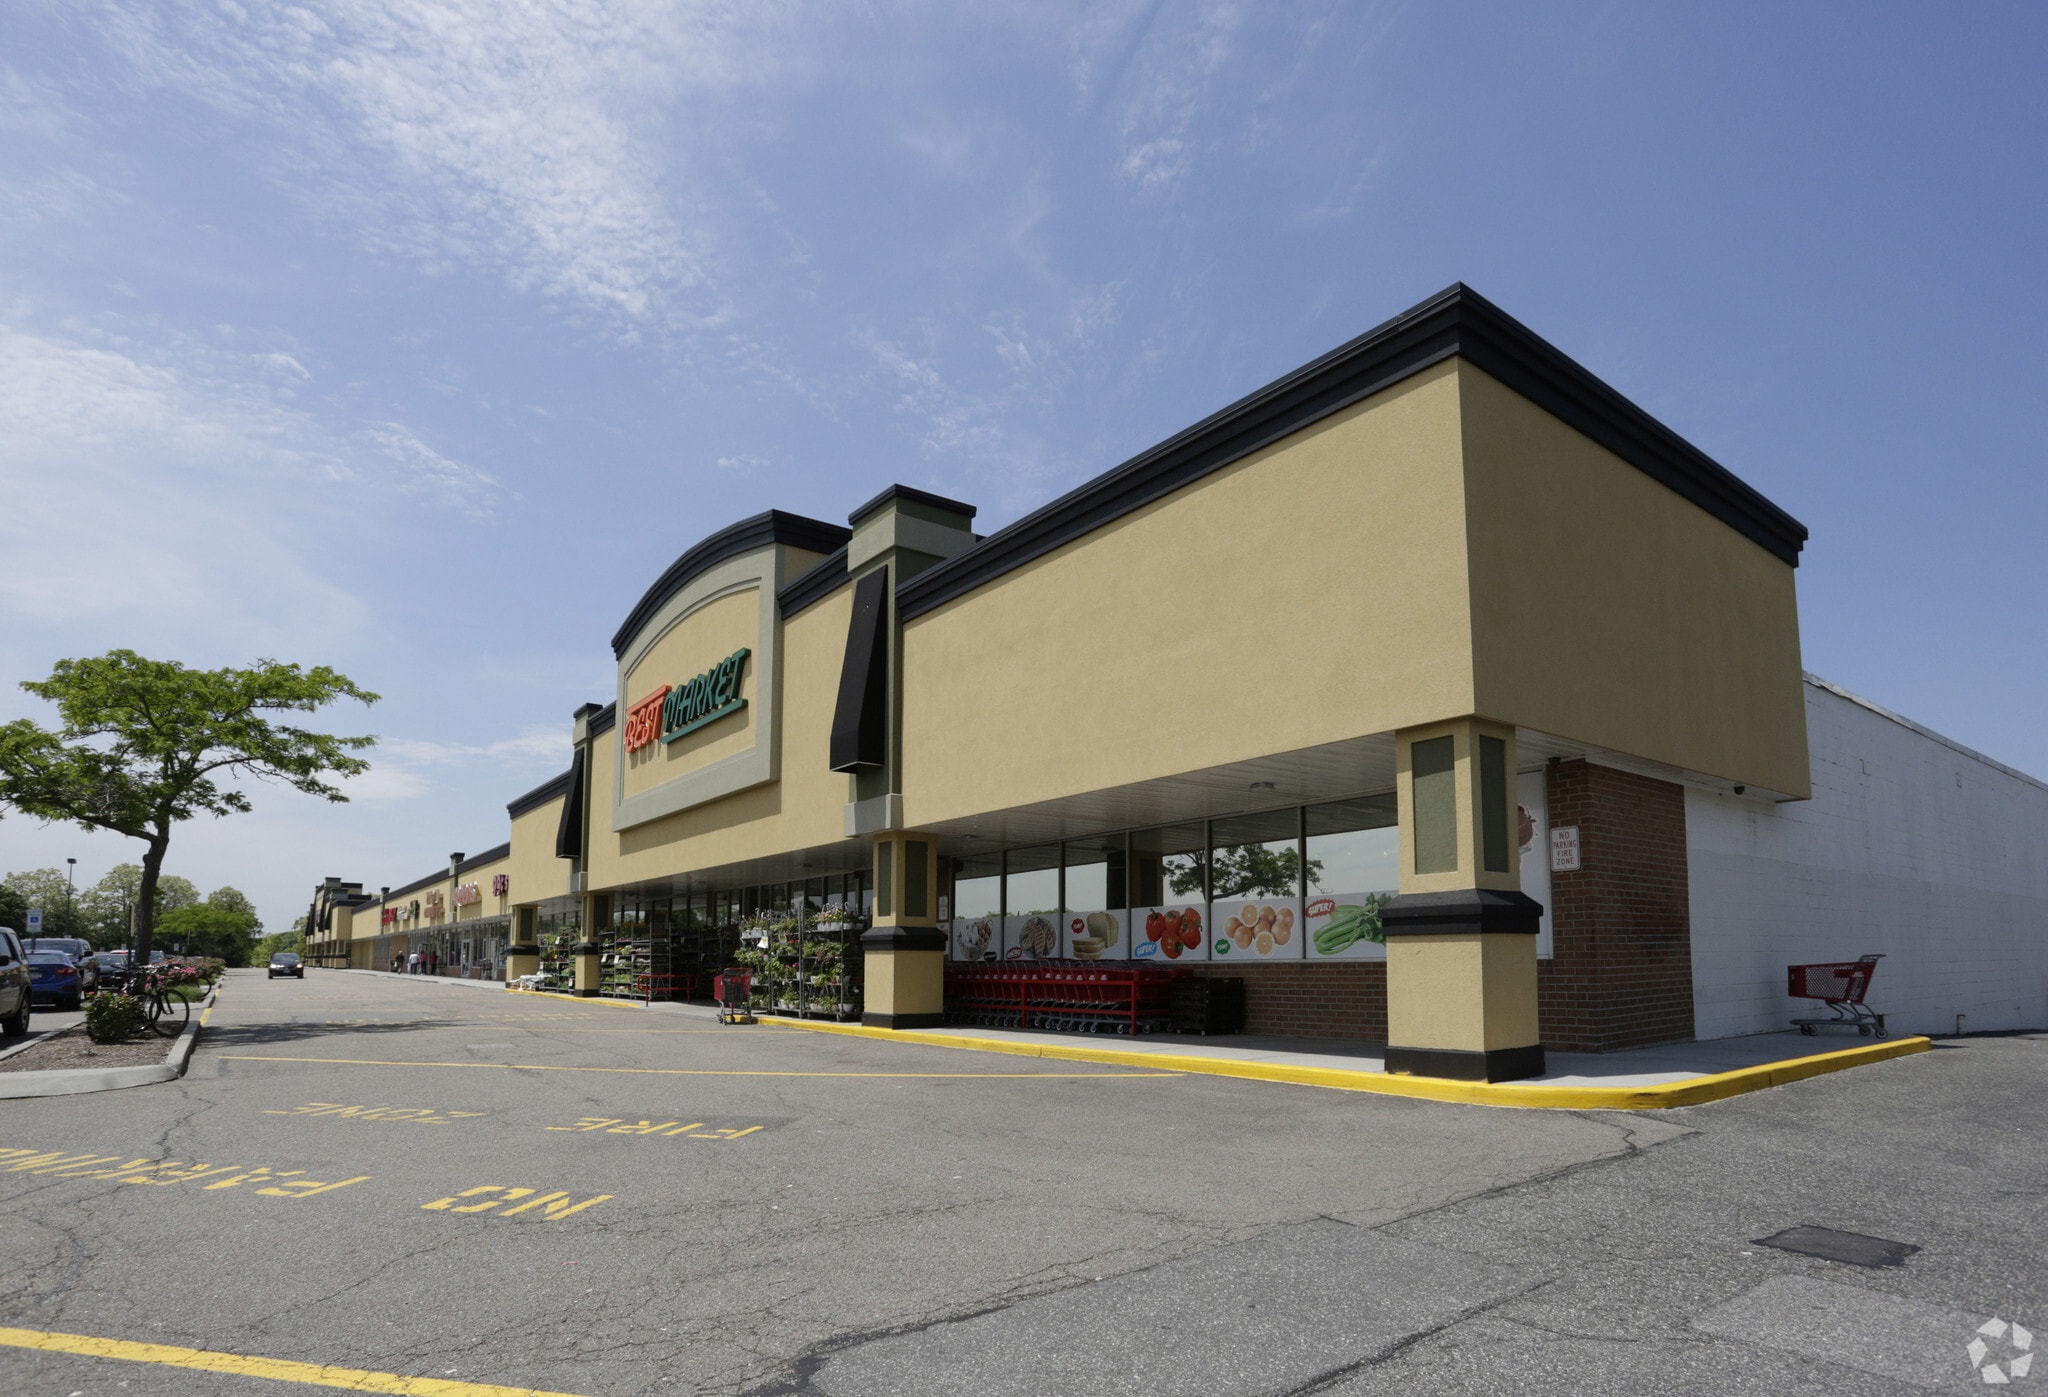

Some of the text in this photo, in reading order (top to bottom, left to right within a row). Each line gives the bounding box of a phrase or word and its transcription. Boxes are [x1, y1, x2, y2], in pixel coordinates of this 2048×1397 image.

[625, 648, 751, 753] BEST MARKET
[1559, 831, 1569, 839] NO
[1553, 840, 1576, 848] PARKING
[1557, 849, 1572, 857] FIRE
[1557, 857, 1574, 865] ZONE
[1307, 901, 1333, 916] SUPER!
[262, 1102, 764, 1140] FIRE ZONE
[420, 1186, 613, 1221] NO
